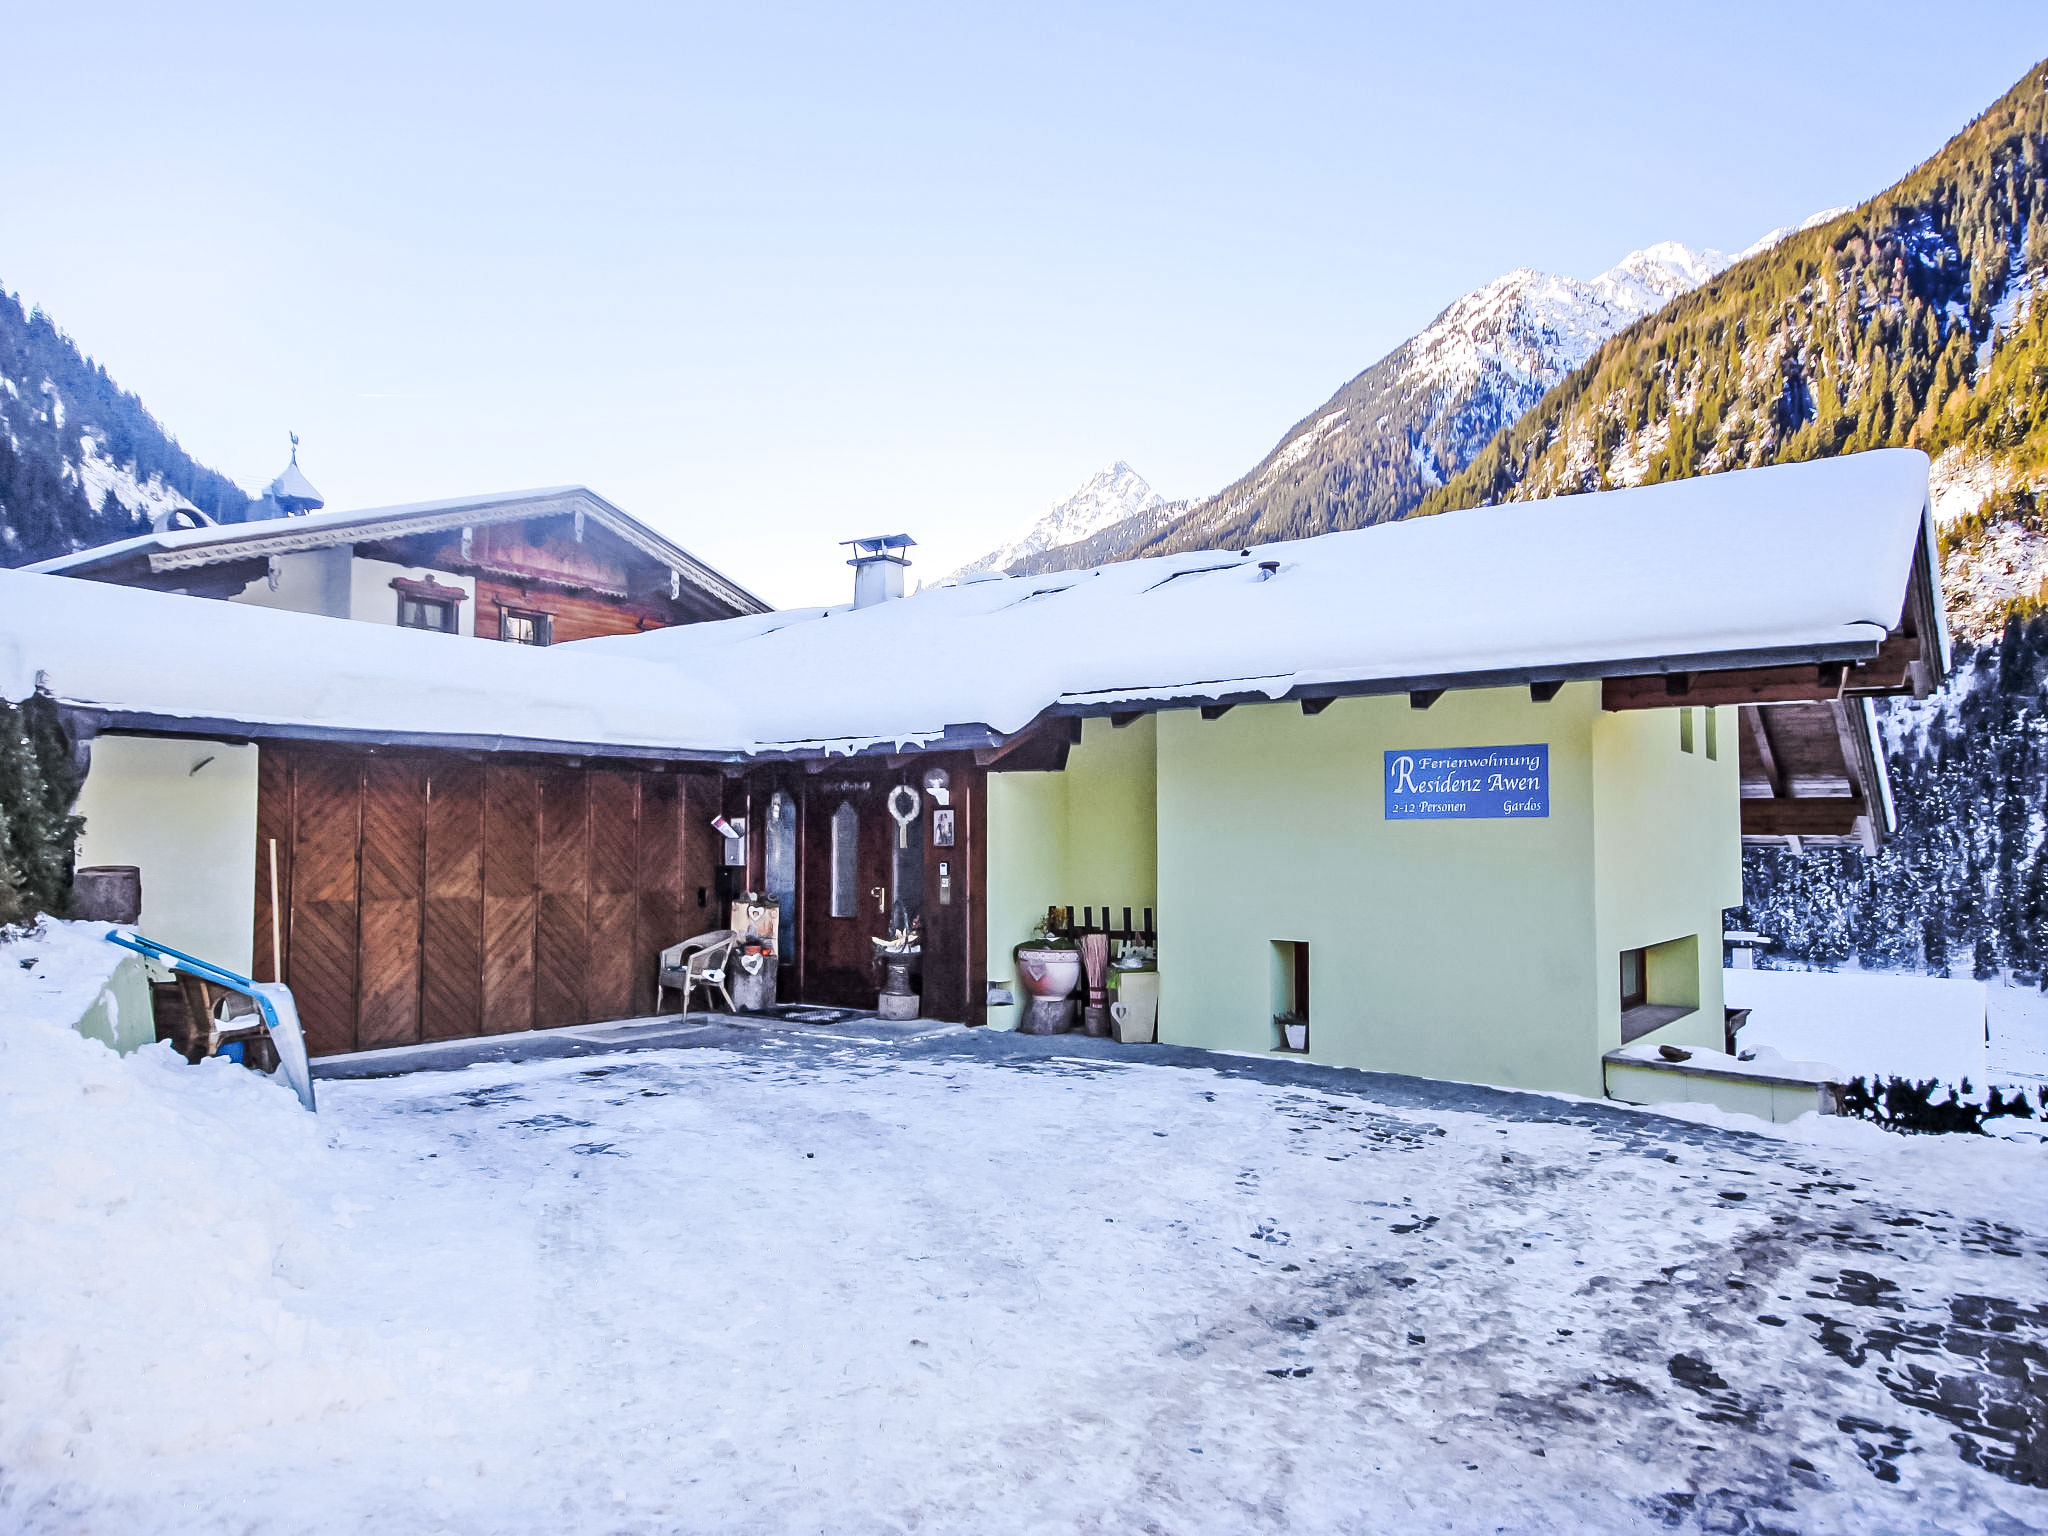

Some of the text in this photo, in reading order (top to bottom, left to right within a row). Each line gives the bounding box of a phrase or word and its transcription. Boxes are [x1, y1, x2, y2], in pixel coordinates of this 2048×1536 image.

[1419, 753, 1540, 770] Ferienwohnung
[1391, 756, 1540, 793] Residenz Awen
[1392, 801, 1466, 813] 2-12 Personen
[1503, 798, 1541, 814] Gardos
